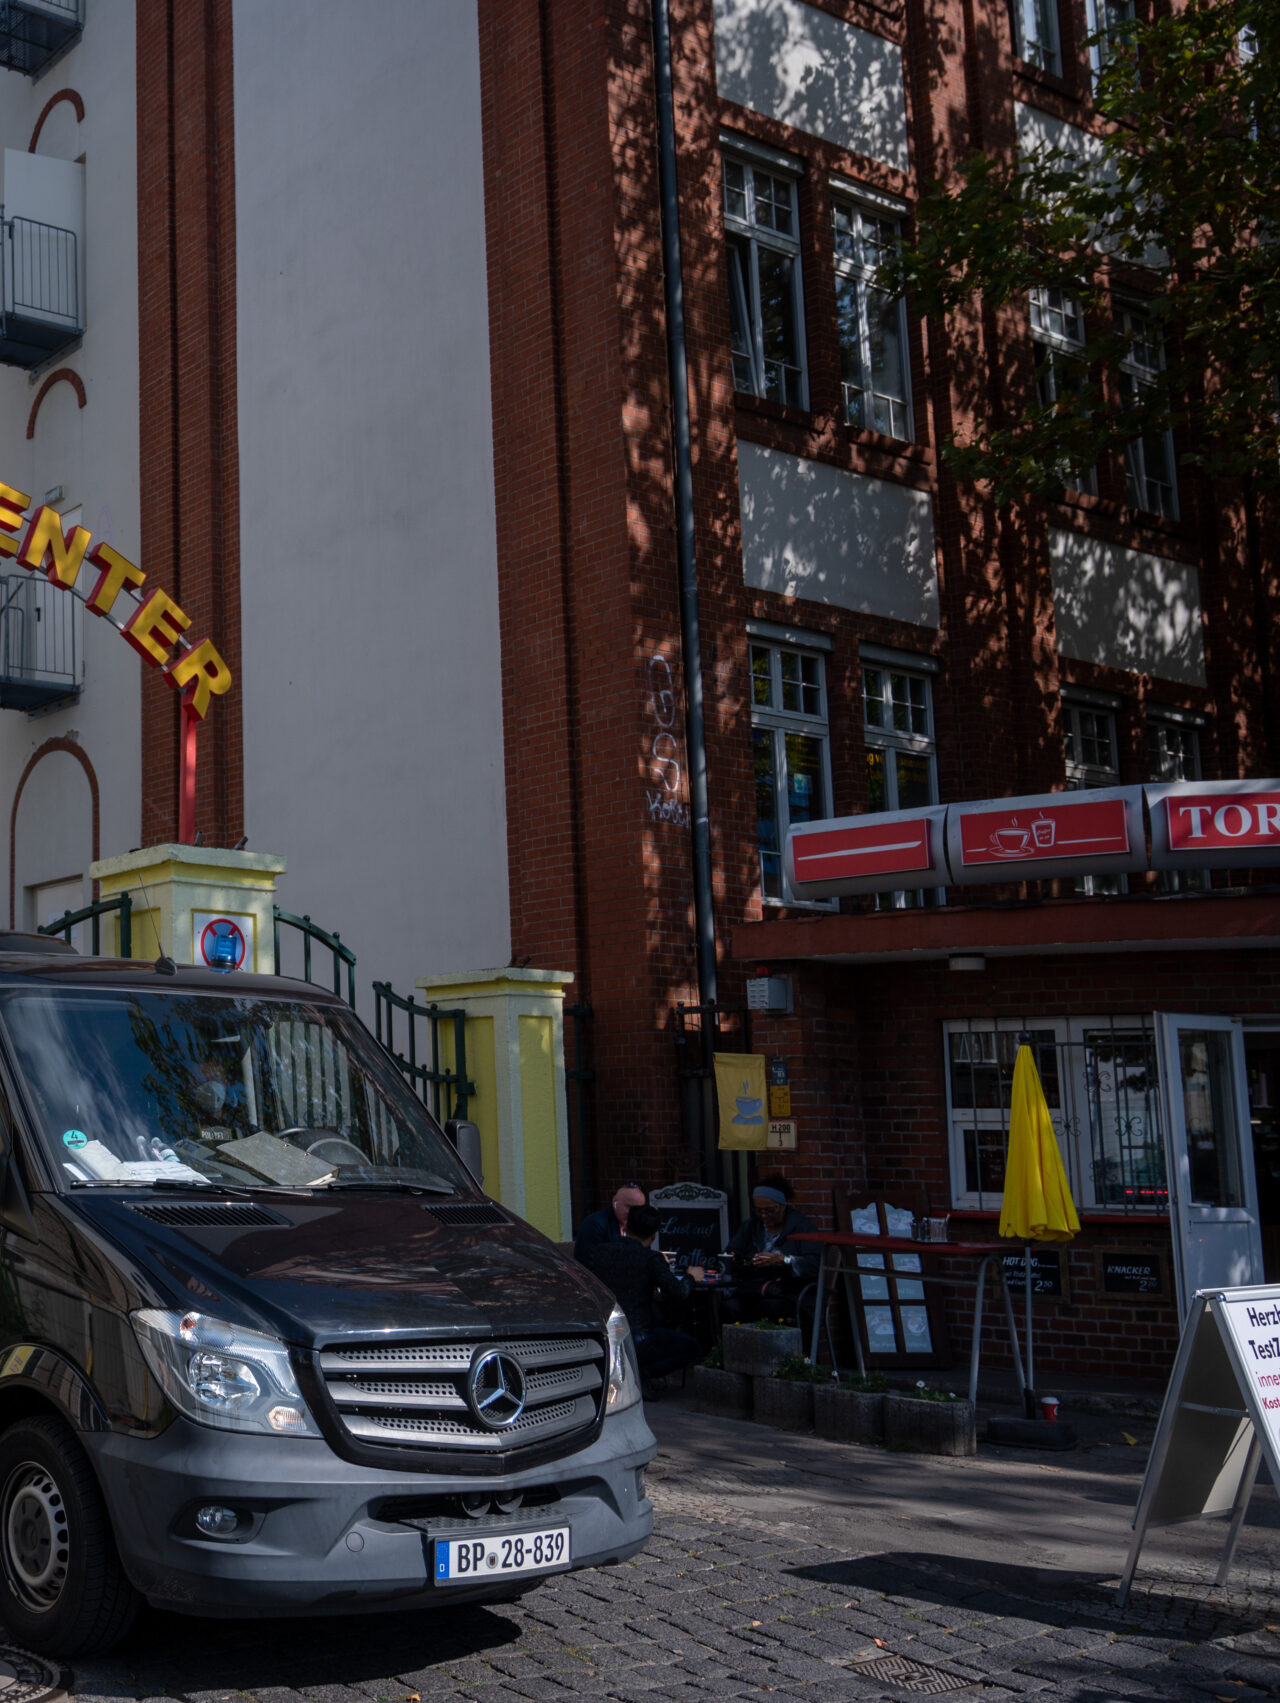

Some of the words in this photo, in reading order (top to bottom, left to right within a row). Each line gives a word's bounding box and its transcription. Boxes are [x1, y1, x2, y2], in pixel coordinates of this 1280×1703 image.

[457, 1542, 485, 1573] BP
[501, 1532, 565, 1569] 28-839
[439, 1563, 445, 1573] D
